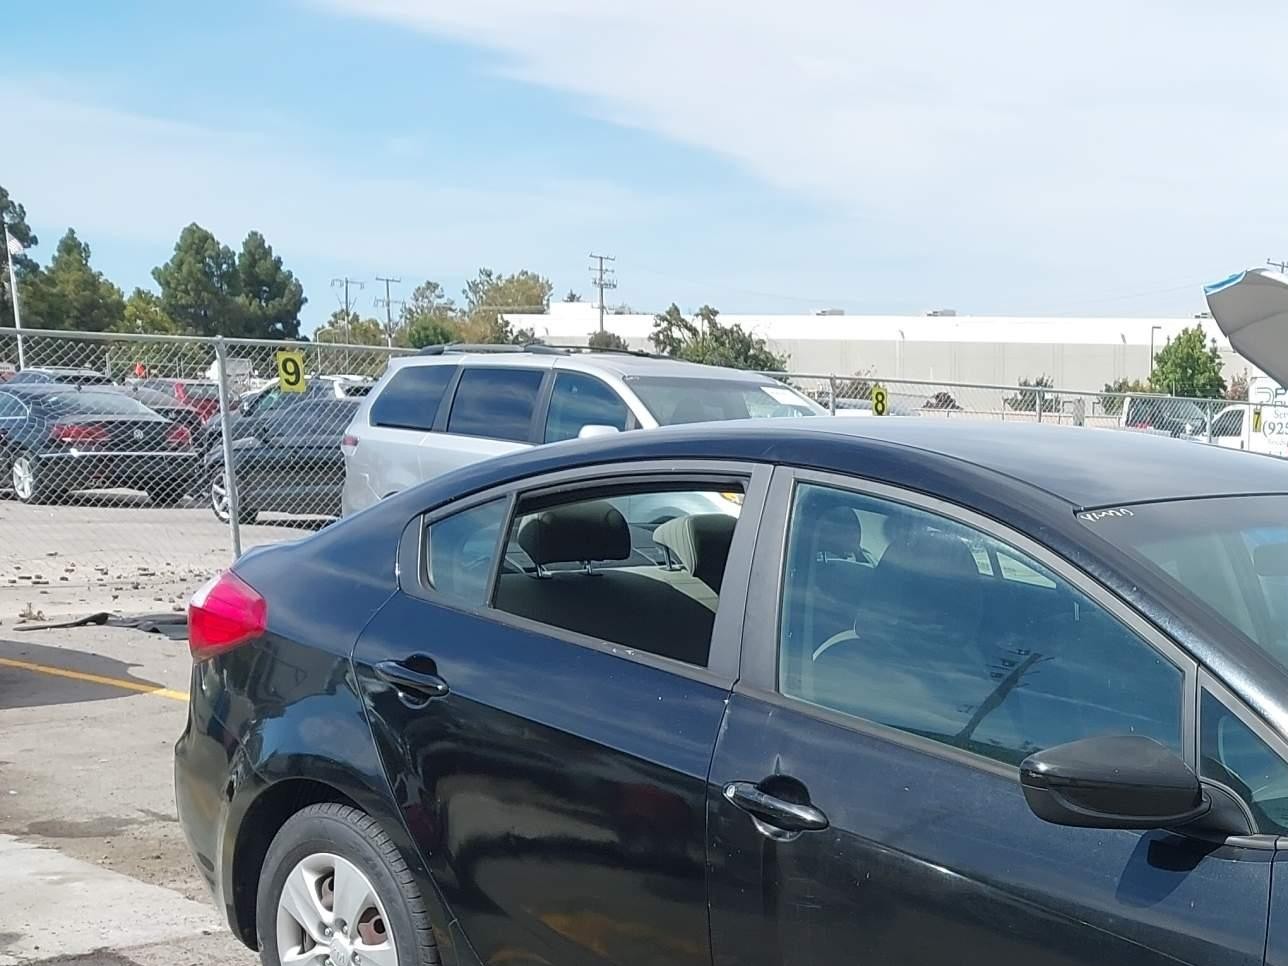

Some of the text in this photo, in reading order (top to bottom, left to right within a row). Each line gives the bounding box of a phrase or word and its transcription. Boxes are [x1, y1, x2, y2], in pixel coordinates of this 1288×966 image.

[281, 357, 301, 386] 9
[874, 391, 886, 416] 8
[1254, 412, 1261, 430] 7
